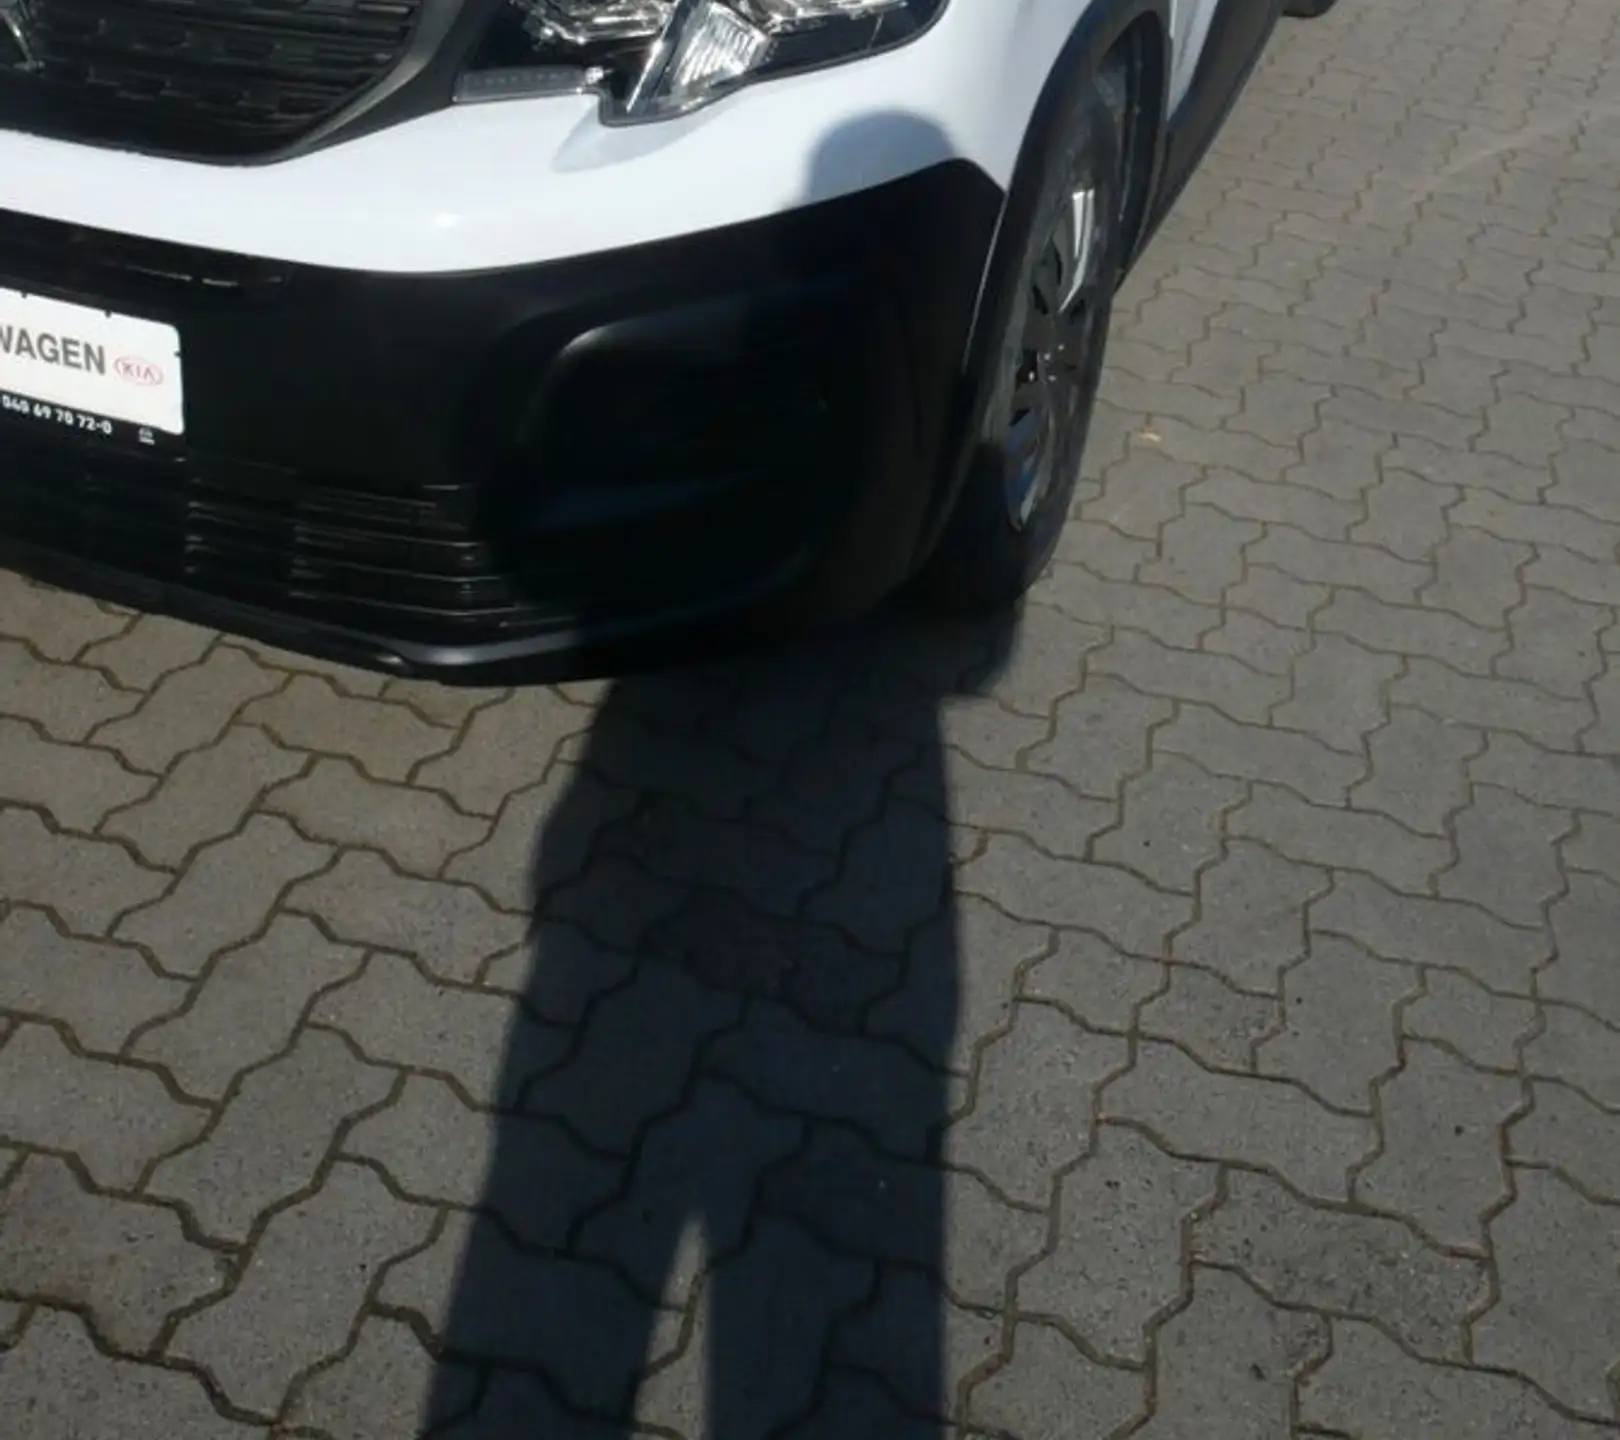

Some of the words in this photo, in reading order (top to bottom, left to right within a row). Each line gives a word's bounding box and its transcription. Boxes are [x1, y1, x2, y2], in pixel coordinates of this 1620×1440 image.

[121, 362, 156, 382] KIA
[55, 408, 74, 426] 70
[76, 414, 113, 435] 72-0
